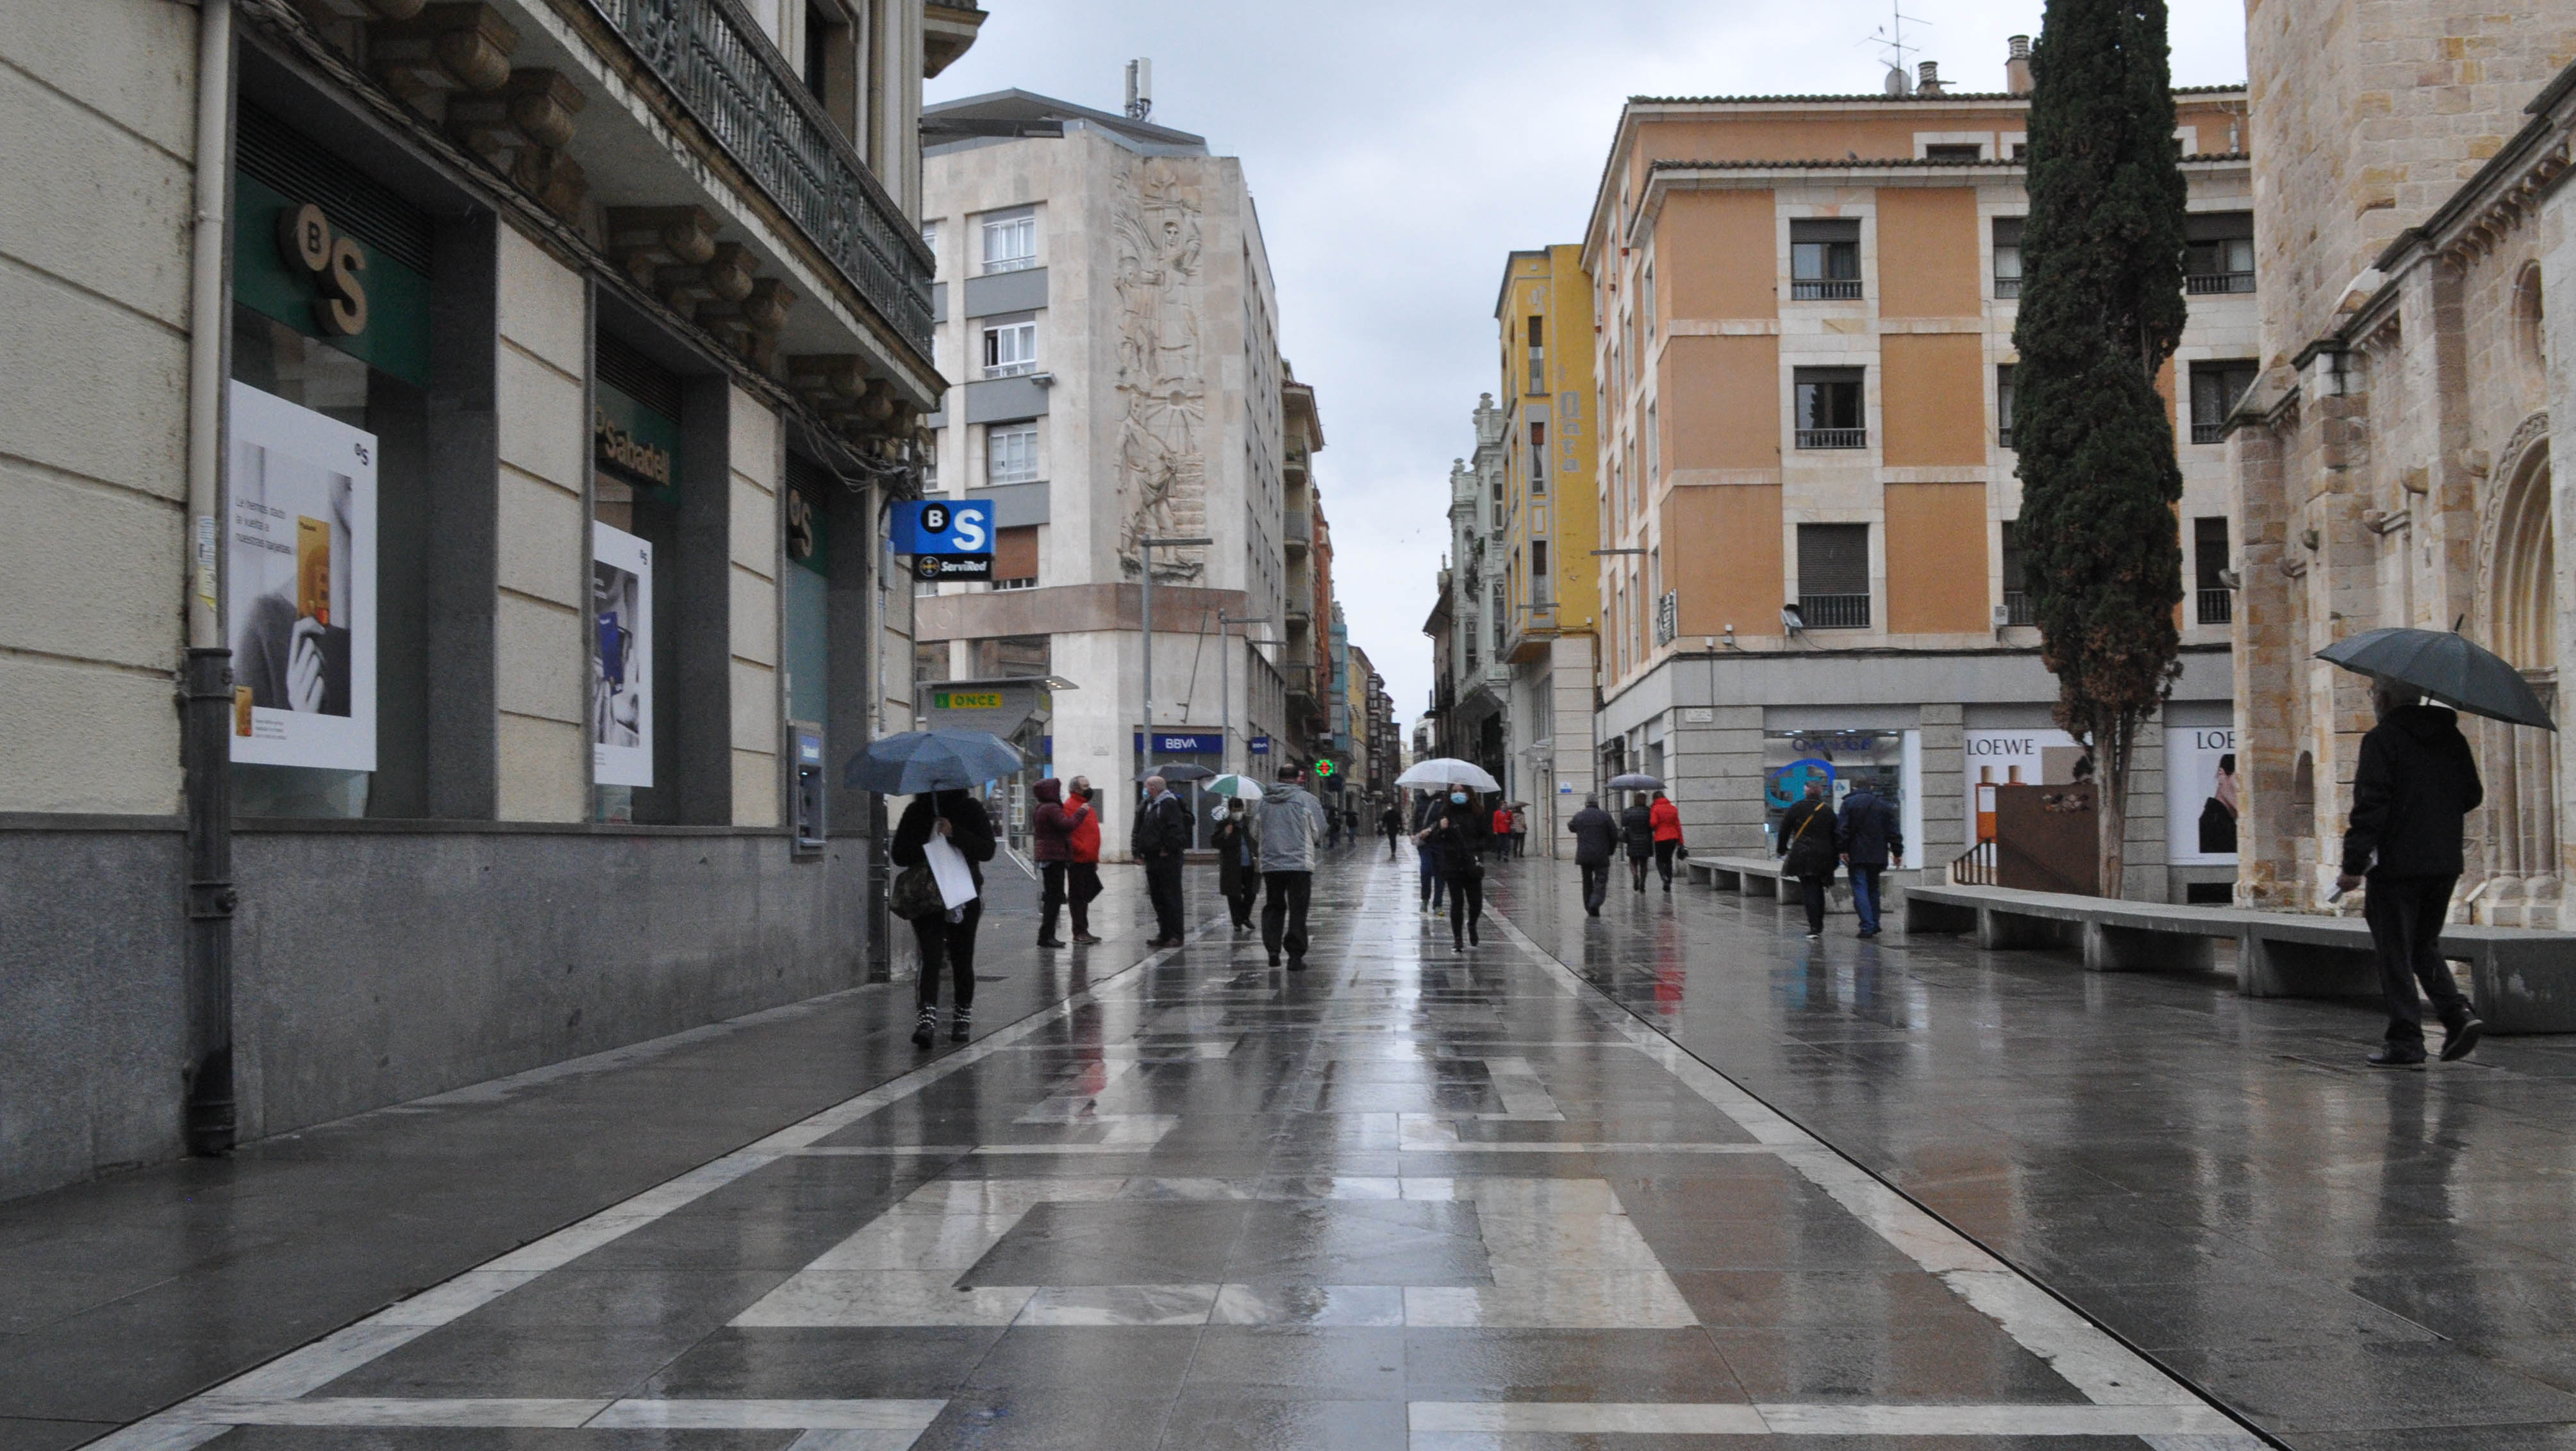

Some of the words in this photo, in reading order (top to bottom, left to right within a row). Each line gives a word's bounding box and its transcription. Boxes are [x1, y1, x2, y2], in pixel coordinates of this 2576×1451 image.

[940, 560, 987, 572] ServiRed
[955, 695, 997, 706] ONCE
[1165, 738, 1197, 749] BBVA
[1966, 738, 2035, 756] LOEWE
